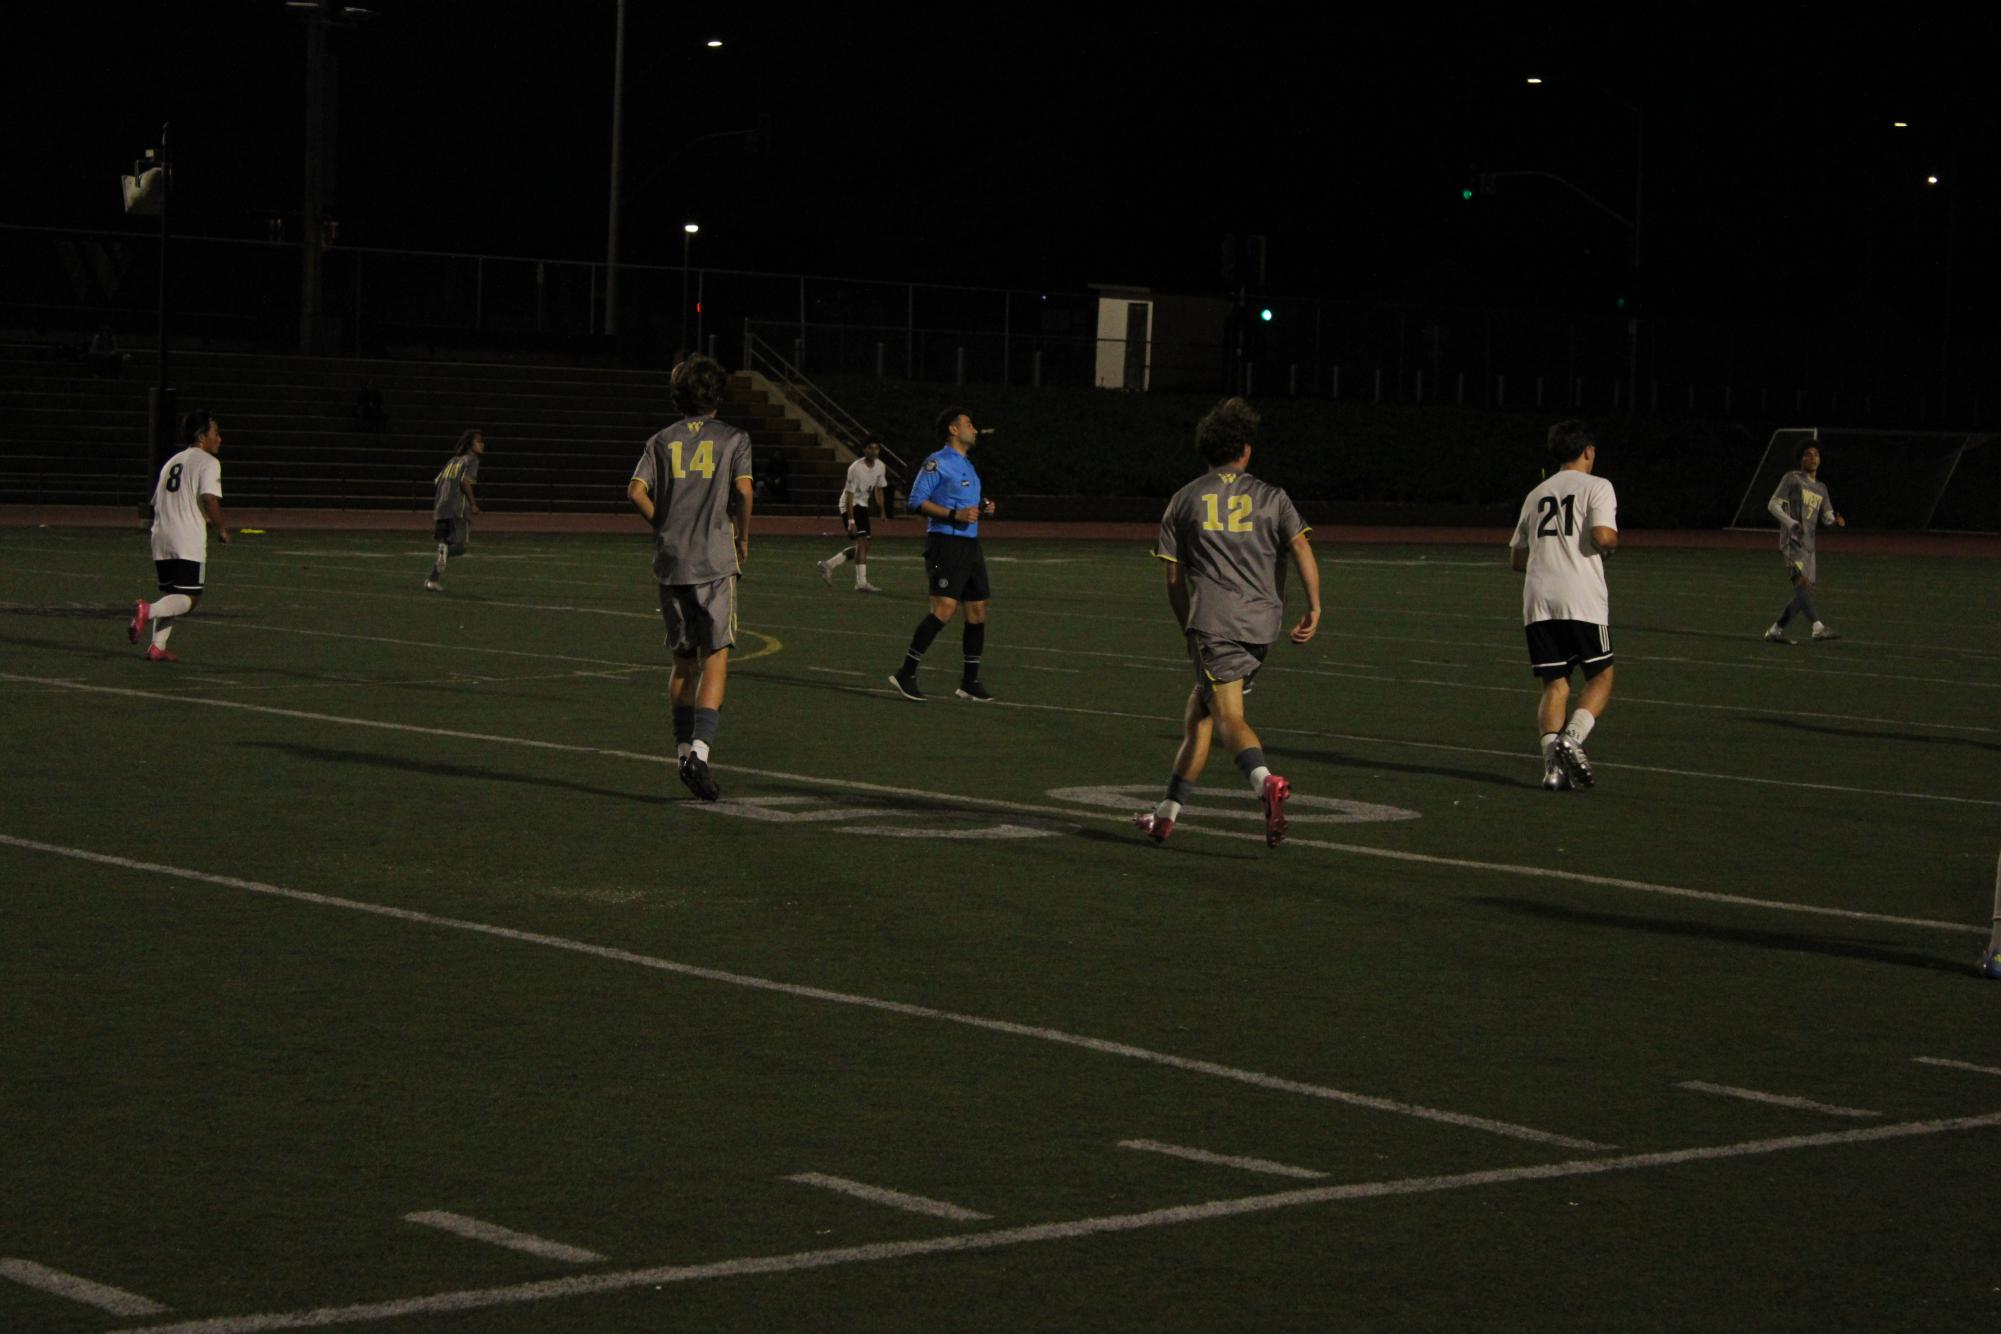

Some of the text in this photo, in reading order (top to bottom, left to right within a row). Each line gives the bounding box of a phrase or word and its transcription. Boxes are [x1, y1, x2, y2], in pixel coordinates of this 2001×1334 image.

[166, 463, 183, 492] 8
[667, 440, 716, 479] 14
[1202, 493, 1254, 532] 12
[1537, 494, 1575, 538] 21
